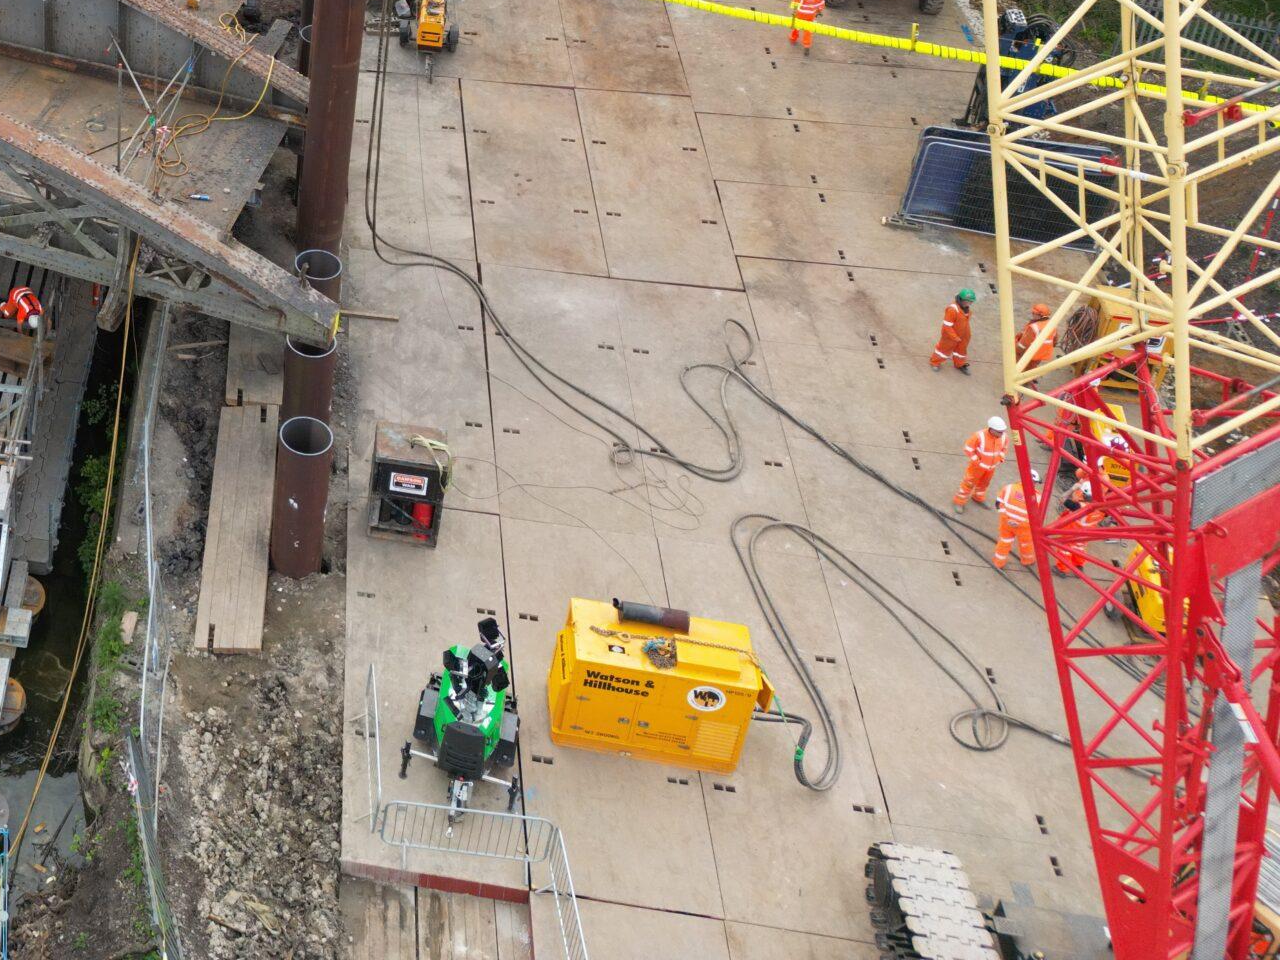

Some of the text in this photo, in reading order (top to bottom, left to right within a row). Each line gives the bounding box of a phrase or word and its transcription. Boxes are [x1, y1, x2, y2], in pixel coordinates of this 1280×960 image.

[583, 678, 649, 698] Hillhouse
[586, 669, 655, 689] Watson &
